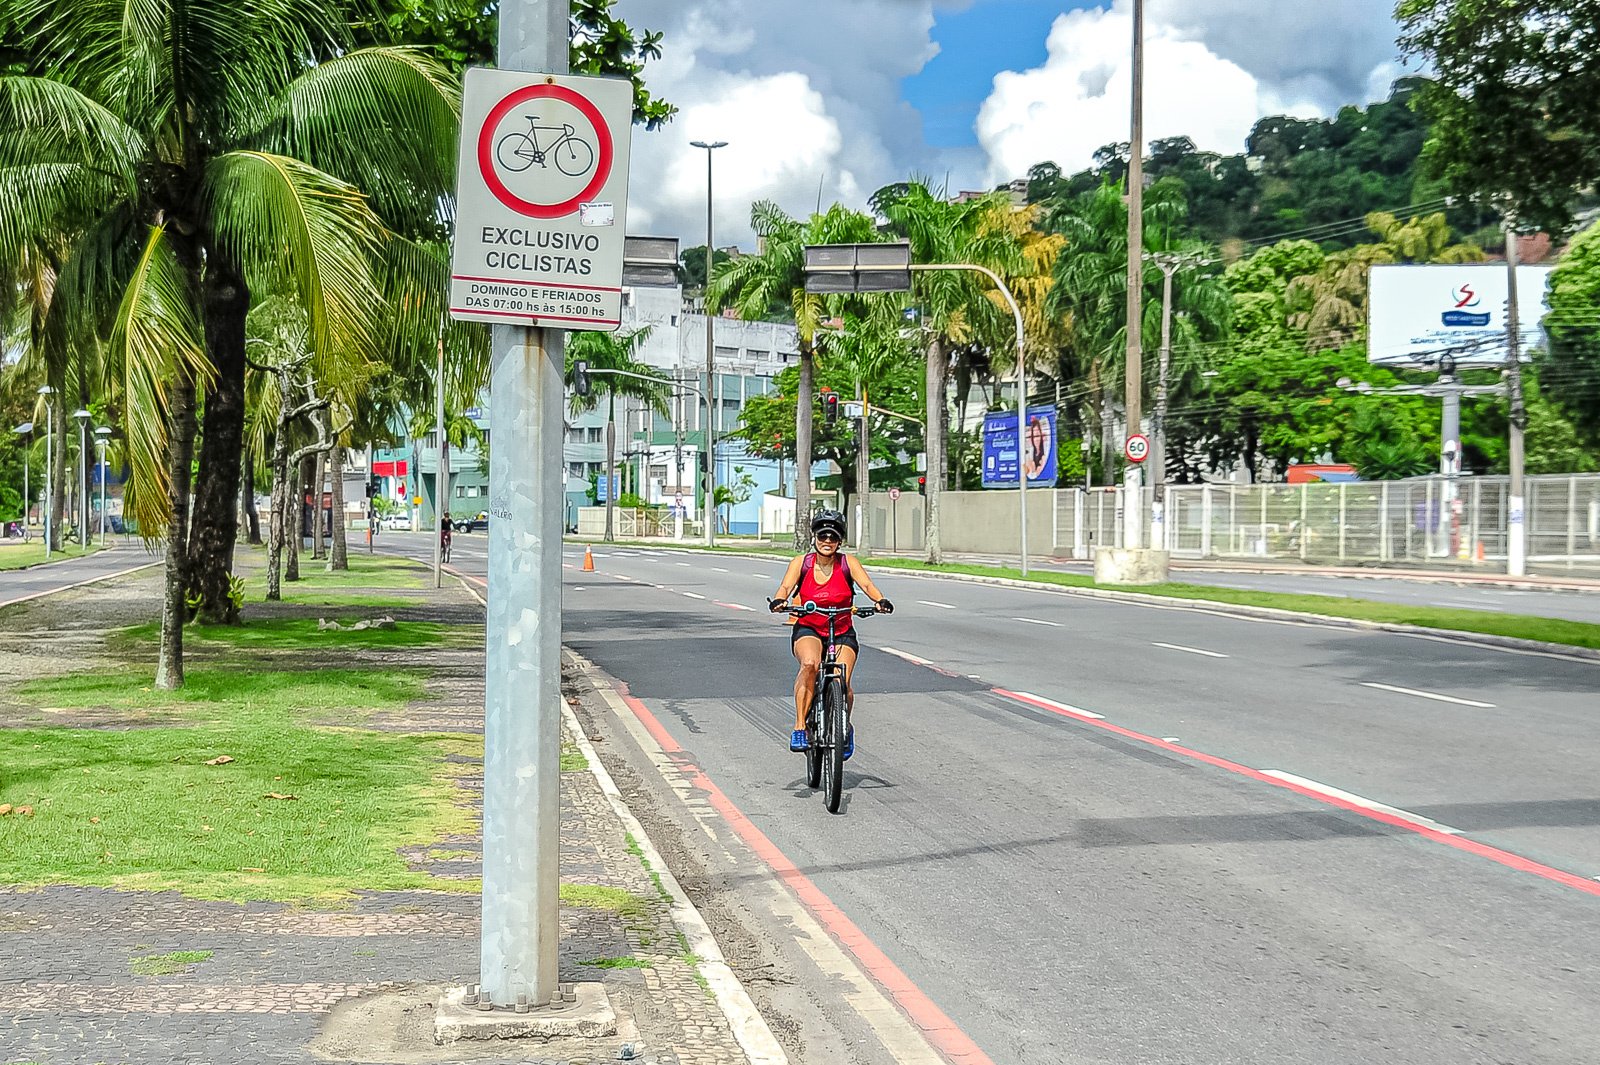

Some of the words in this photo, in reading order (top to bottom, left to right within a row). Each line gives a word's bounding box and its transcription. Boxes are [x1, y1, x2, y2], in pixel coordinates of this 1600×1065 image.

[481, 226, 599, 251] EXCLUSIVO
[486, 251, 592, 275] CICLISTAS
[471, 284, 528, 297] DOMINGO
[531, 289, 538, 298] E
[542, 290, 601, 303] FERIADOS
[466, 297, 490, 307] DAS
[493, 299, 522, 310] 07:00
[526, 302, 539, 312] hs
[542, 302, 555, 313] às
[560, 304, 588, 315] 15:00
[591, 306, 605, 317] hs
[1130, 442, 1145, 452] 60
